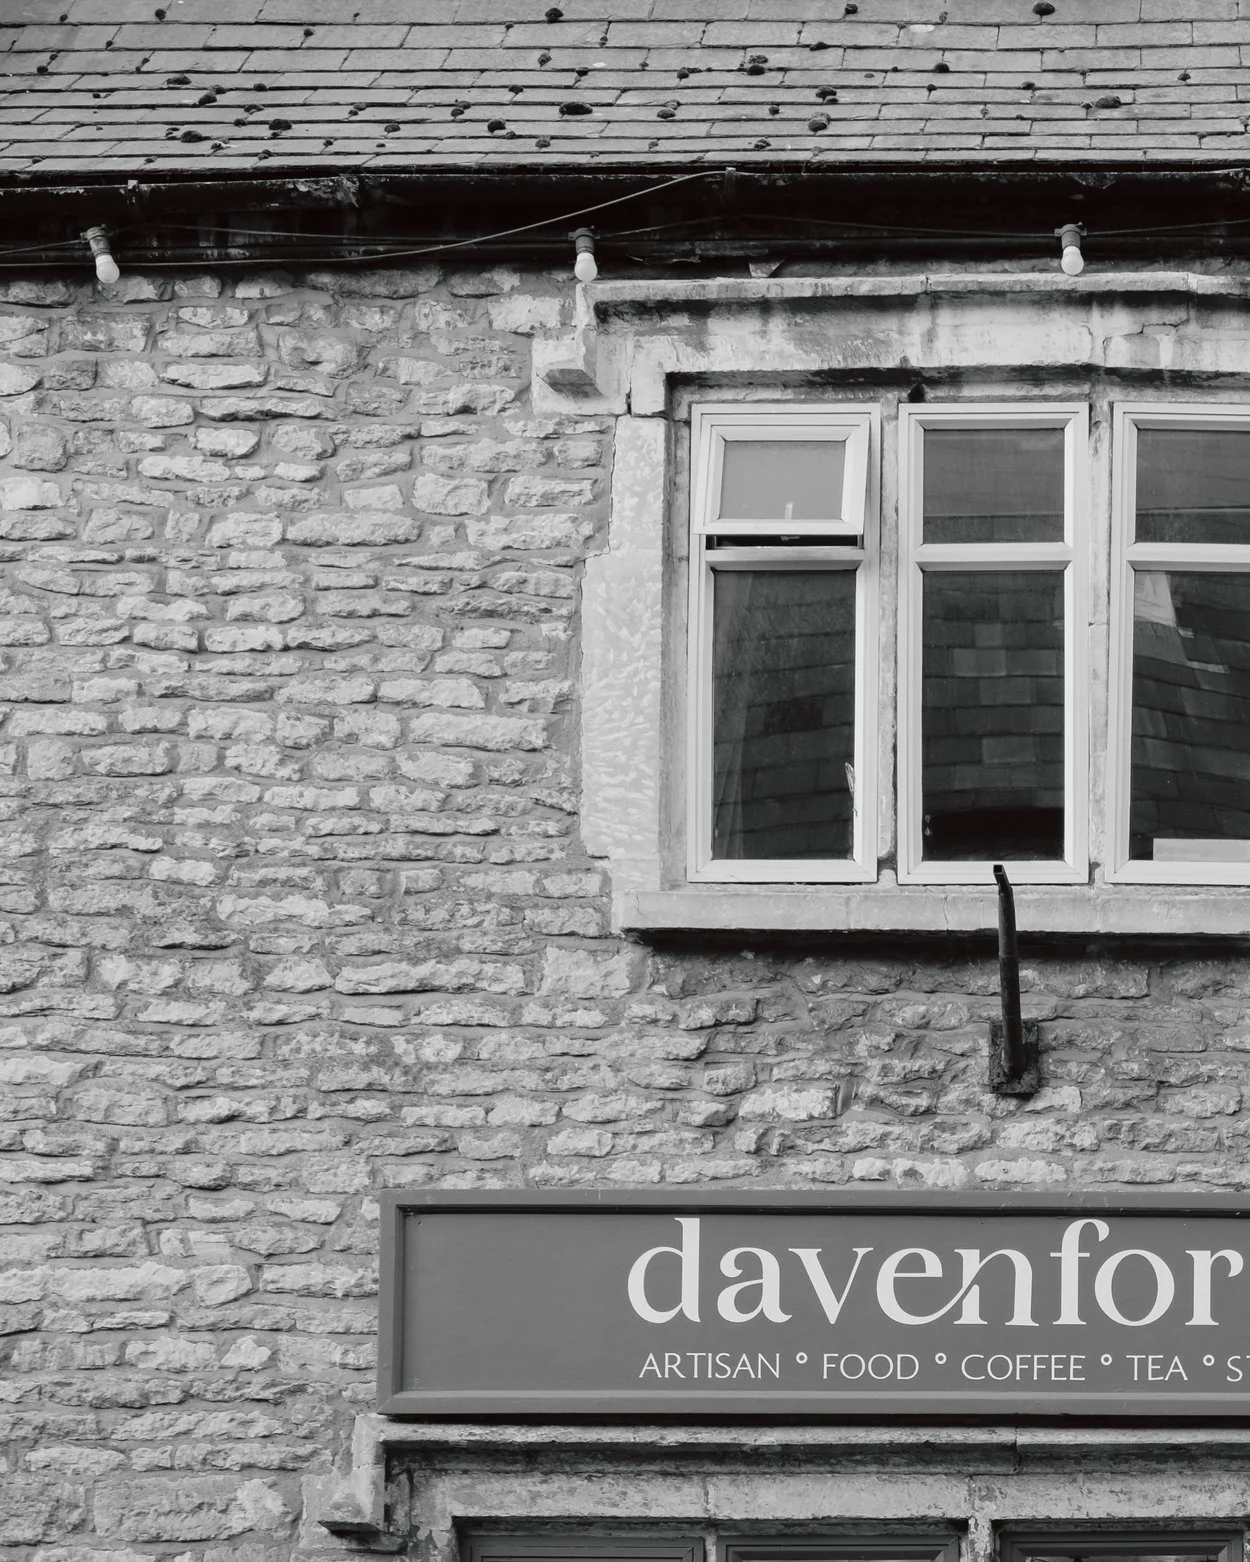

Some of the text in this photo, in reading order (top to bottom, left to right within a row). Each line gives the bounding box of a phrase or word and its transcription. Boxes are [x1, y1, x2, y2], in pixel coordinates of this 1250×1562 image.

[638, 1352, 780, 1380] ARTISAN
[822, 1353, 920, 1381] FOOD
[961, 1354, 1086, 1382] COFFEE
[1125, 1354, 1189, 1382] TEA
